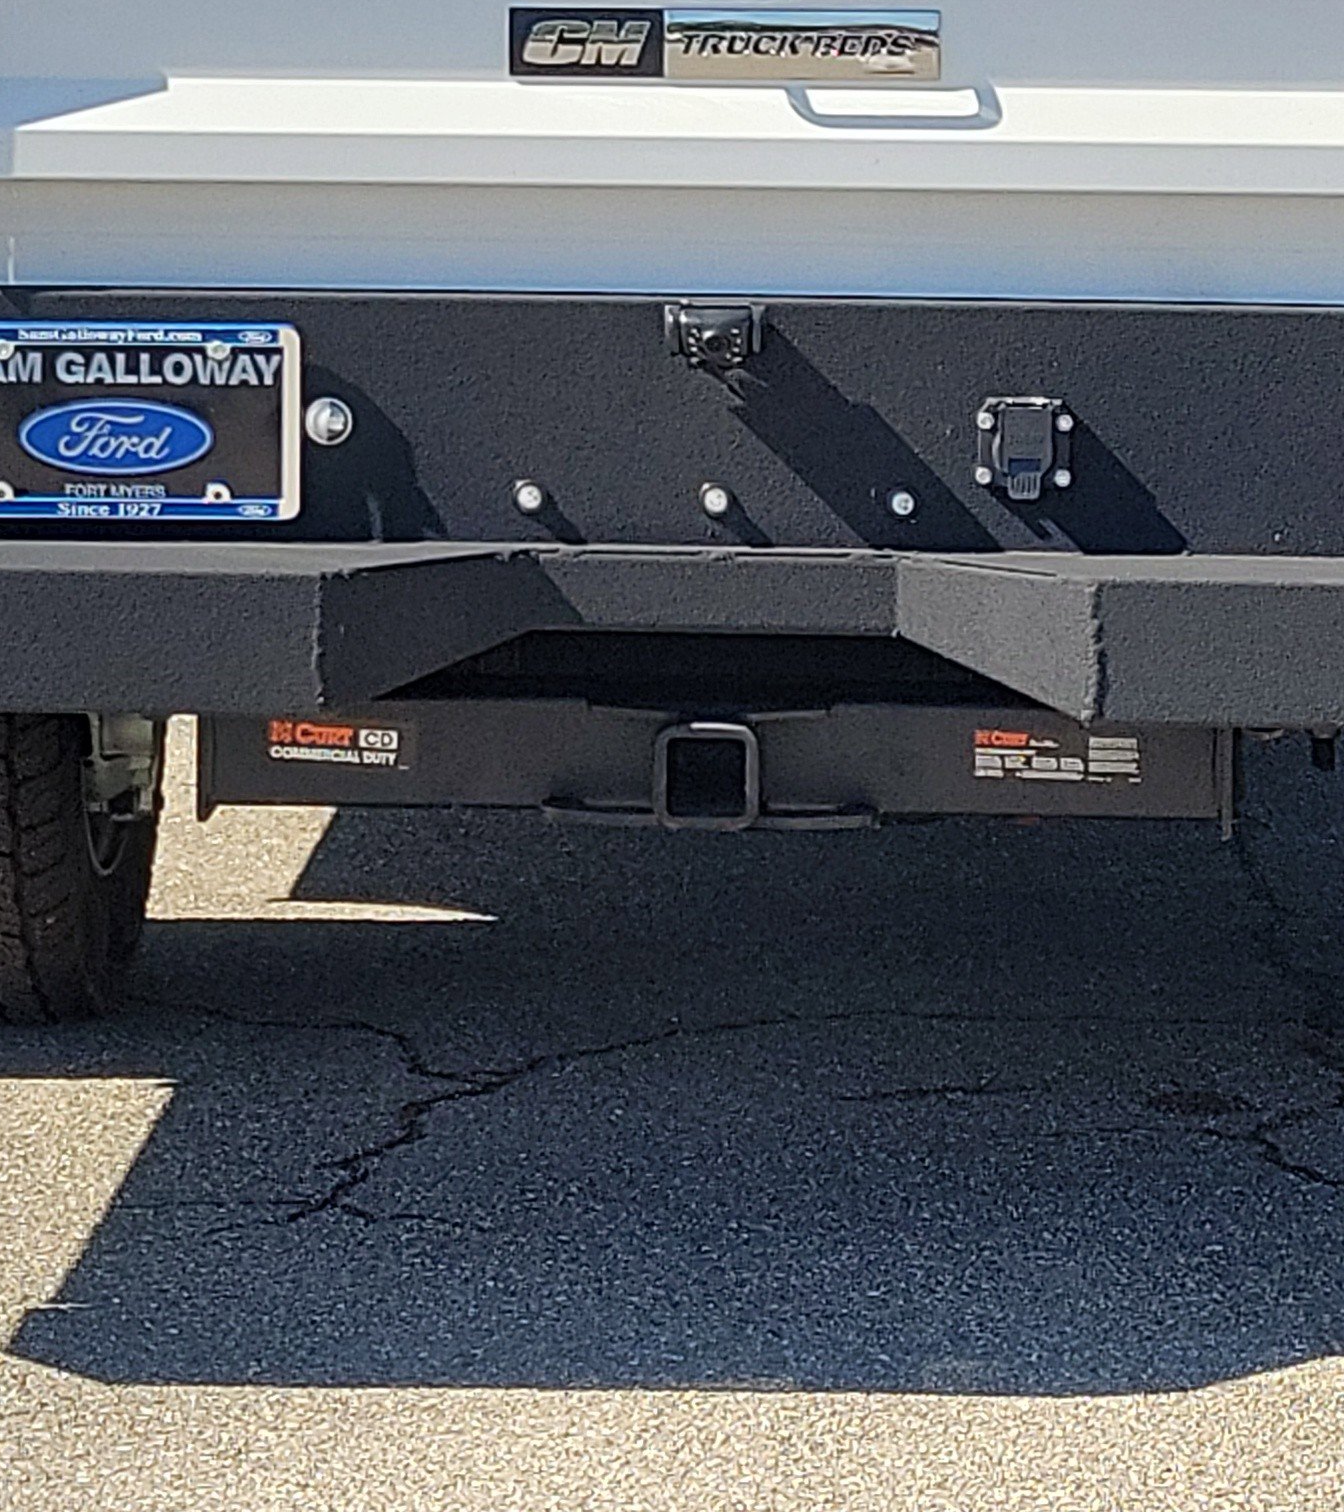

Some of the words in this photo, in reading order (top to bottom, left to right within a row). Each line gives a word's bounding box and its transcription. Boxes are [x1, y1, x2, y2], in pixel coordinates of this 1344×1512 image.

[522, 19, 652, 66] CM
[682, 33, 806, 57] TRUCK
[55, 352, 282, 386] GALLOWAY
[57, 412, 173, 460] Ford
[64, 483, 107, 497] FORT
[57, 503, 111, 516] Since
[118, 504, 162, 517] 1927
[364, 732, 394, 747] CD
[362, 751, 397, 766] DUTY
